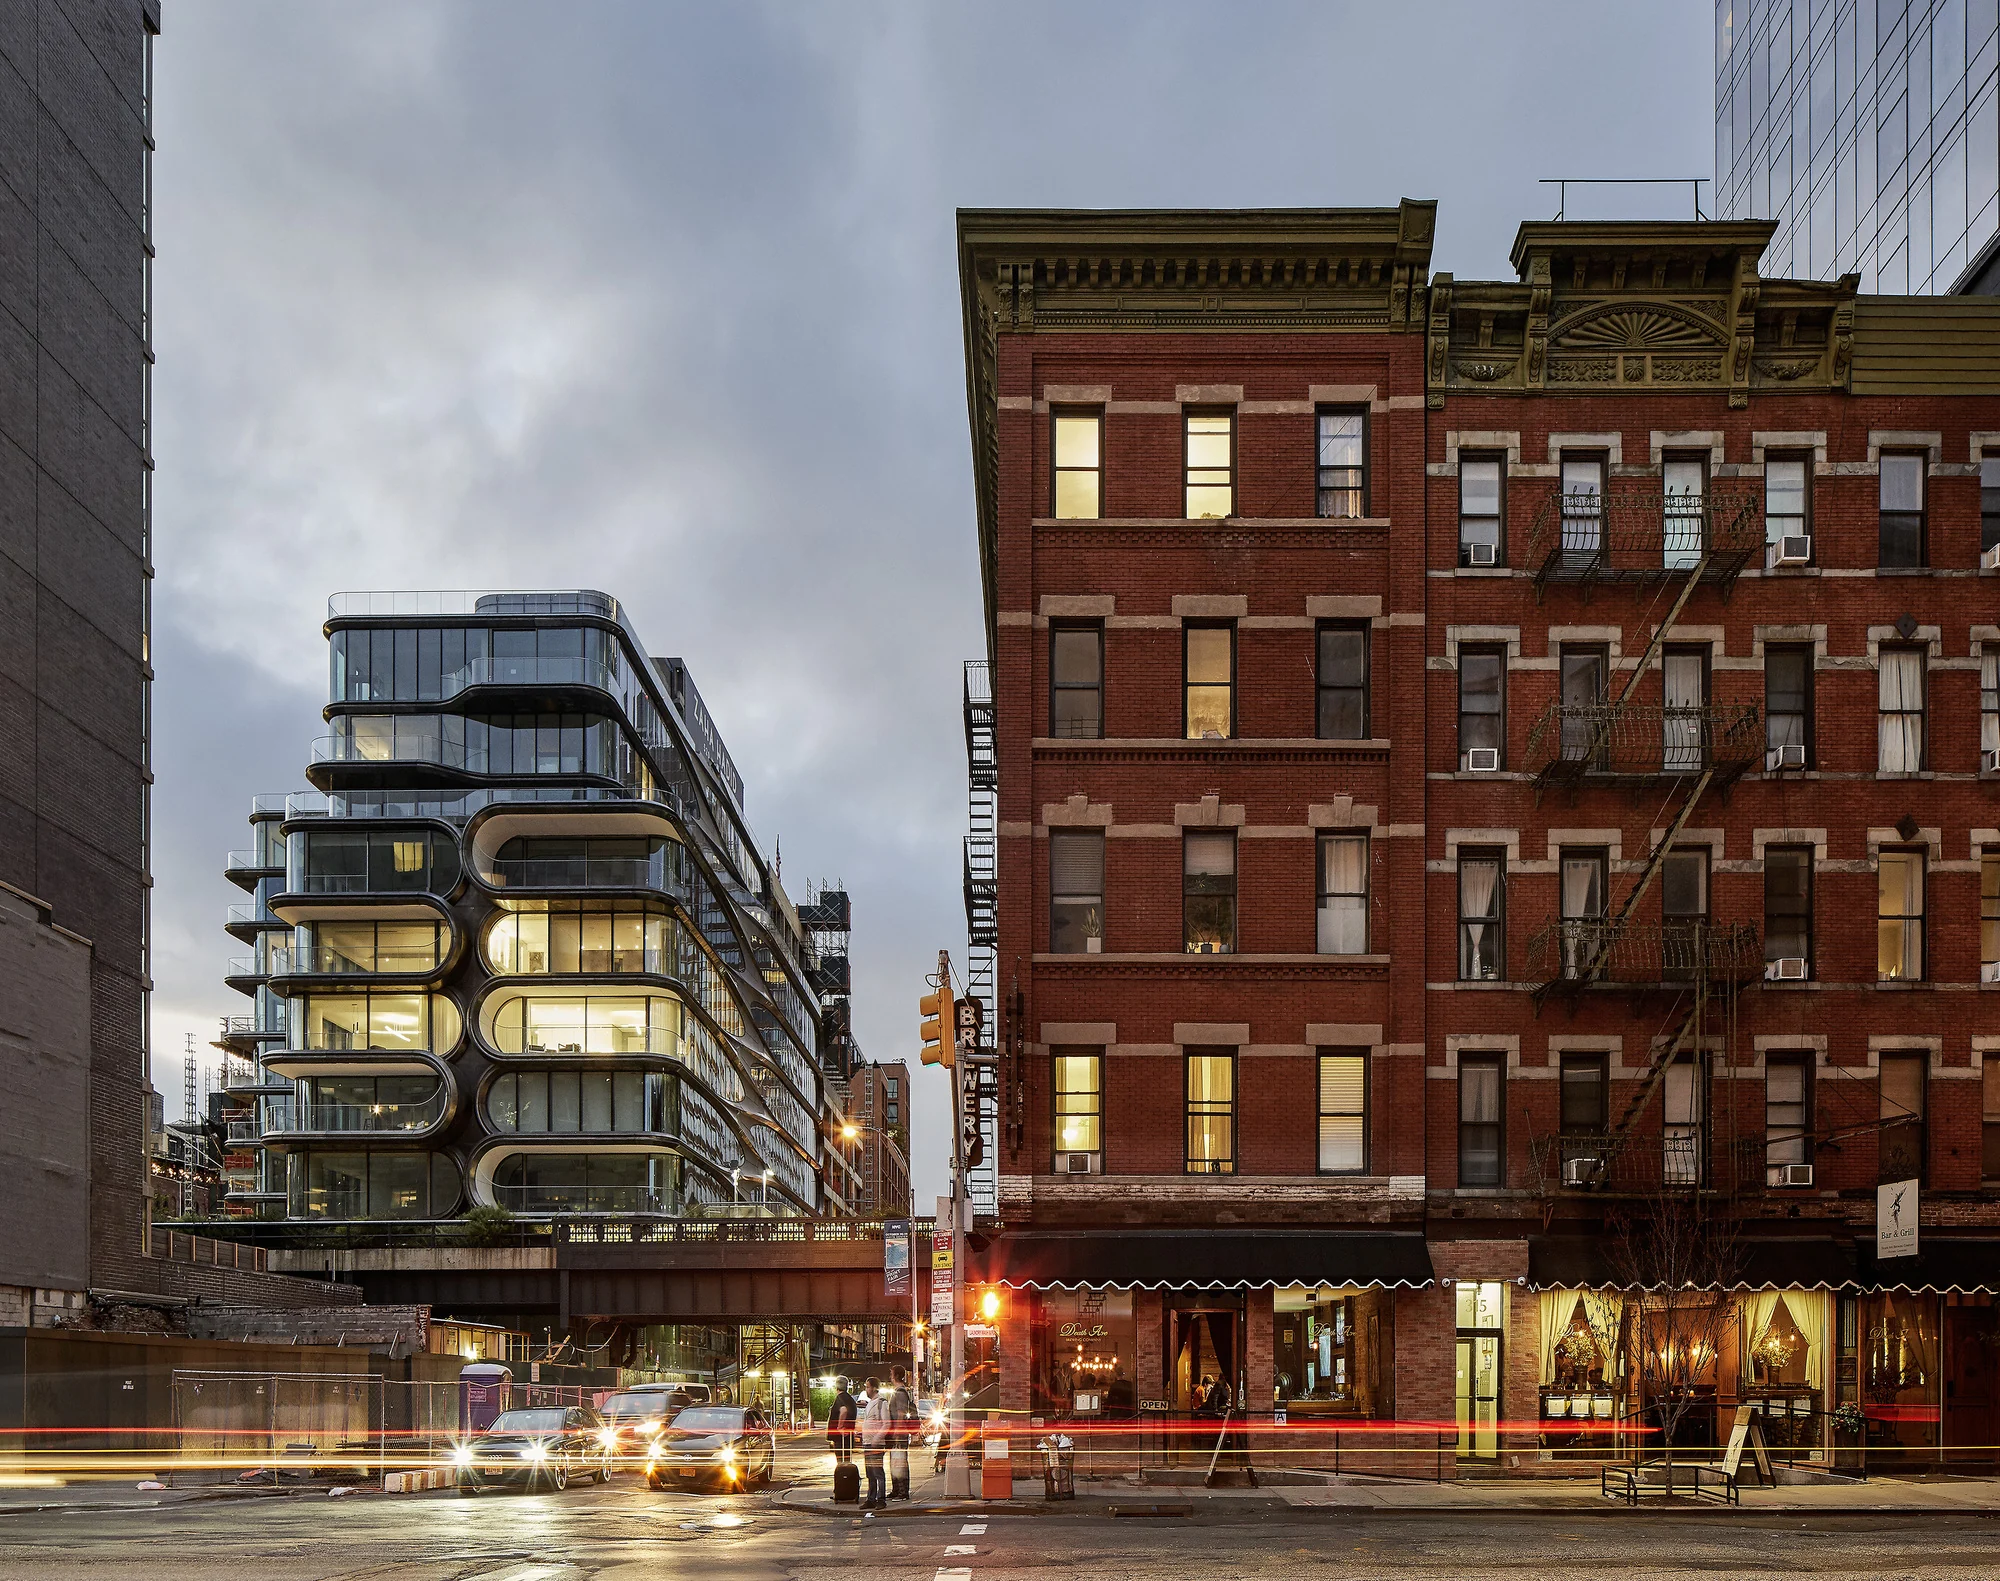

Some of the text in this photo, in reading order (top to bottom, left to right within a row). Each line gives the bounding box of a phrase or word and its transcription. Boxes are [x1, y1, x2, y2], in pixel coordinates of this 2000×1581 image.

[693, 693, 715, 752] ZAHA
[716, 739, 737, 794] HADID
[1881, 1227, 1915, 1239] Bar & Grill
[1465, 1299, 1487, 1312] 315
[1060, 1322, 1108, 1336] Death Ave
